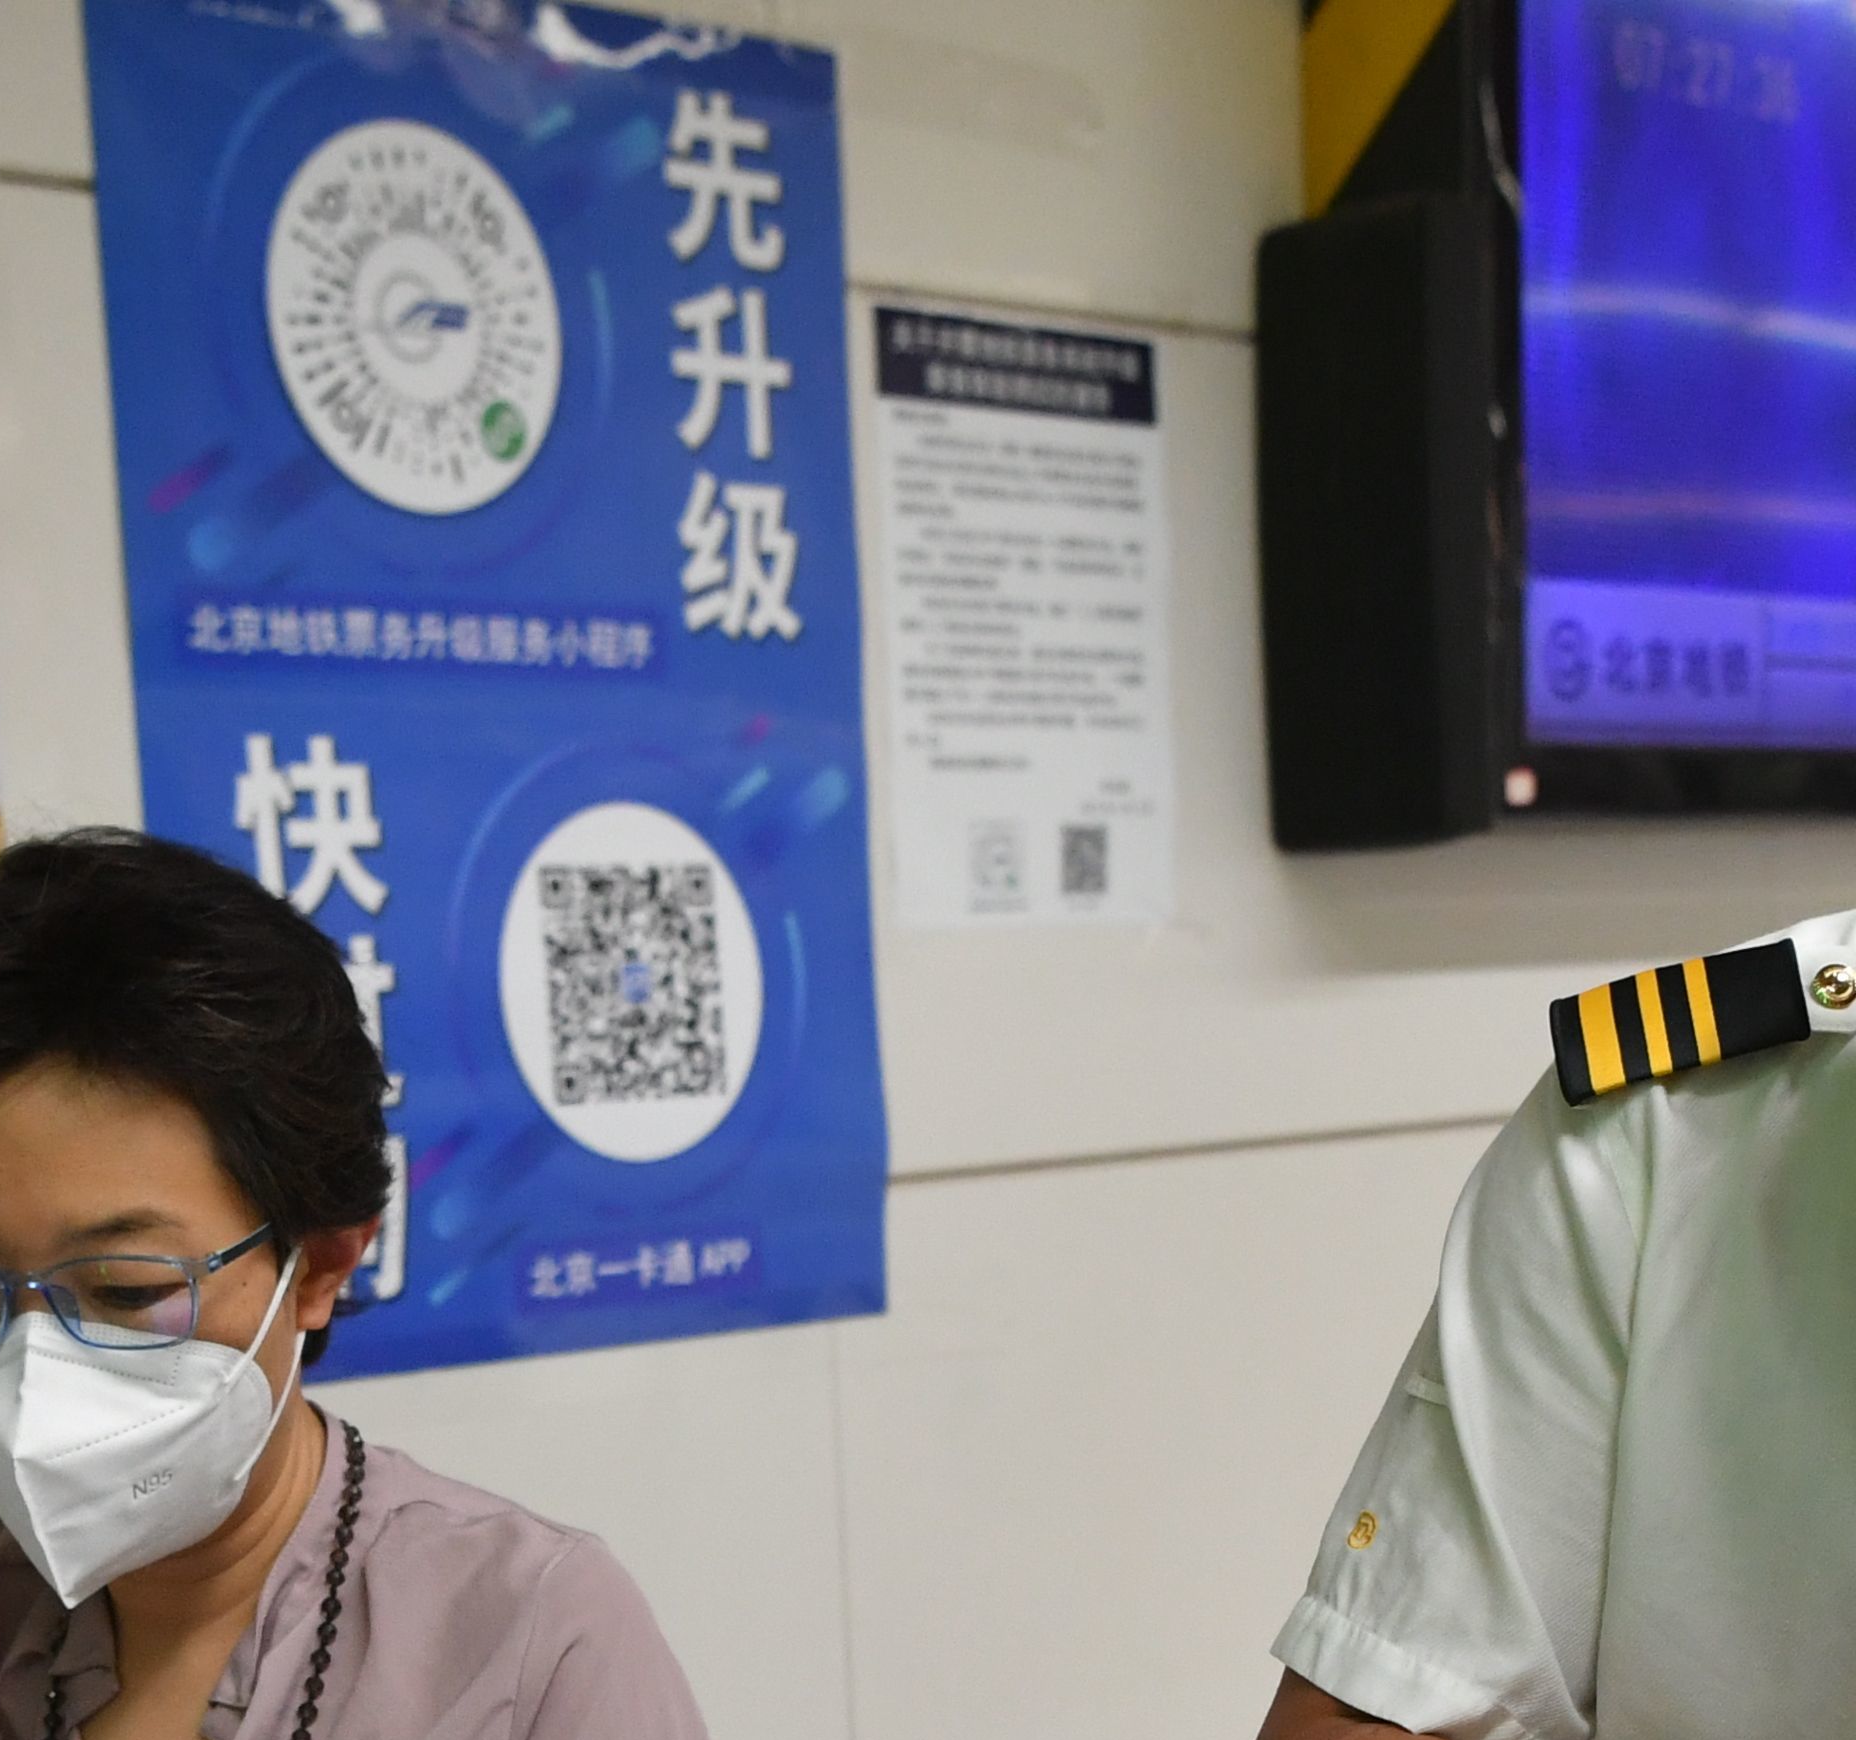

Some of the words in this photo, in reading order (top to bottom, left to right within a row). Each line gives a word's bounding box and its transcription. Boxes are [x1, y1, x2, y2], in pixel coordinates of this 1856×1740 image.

[663, 88, 803, 641] 先升级
[187, 604, 655, 669] 北京地铁票务升级服务小程序
[130, 1469, 174, 1501] N95
